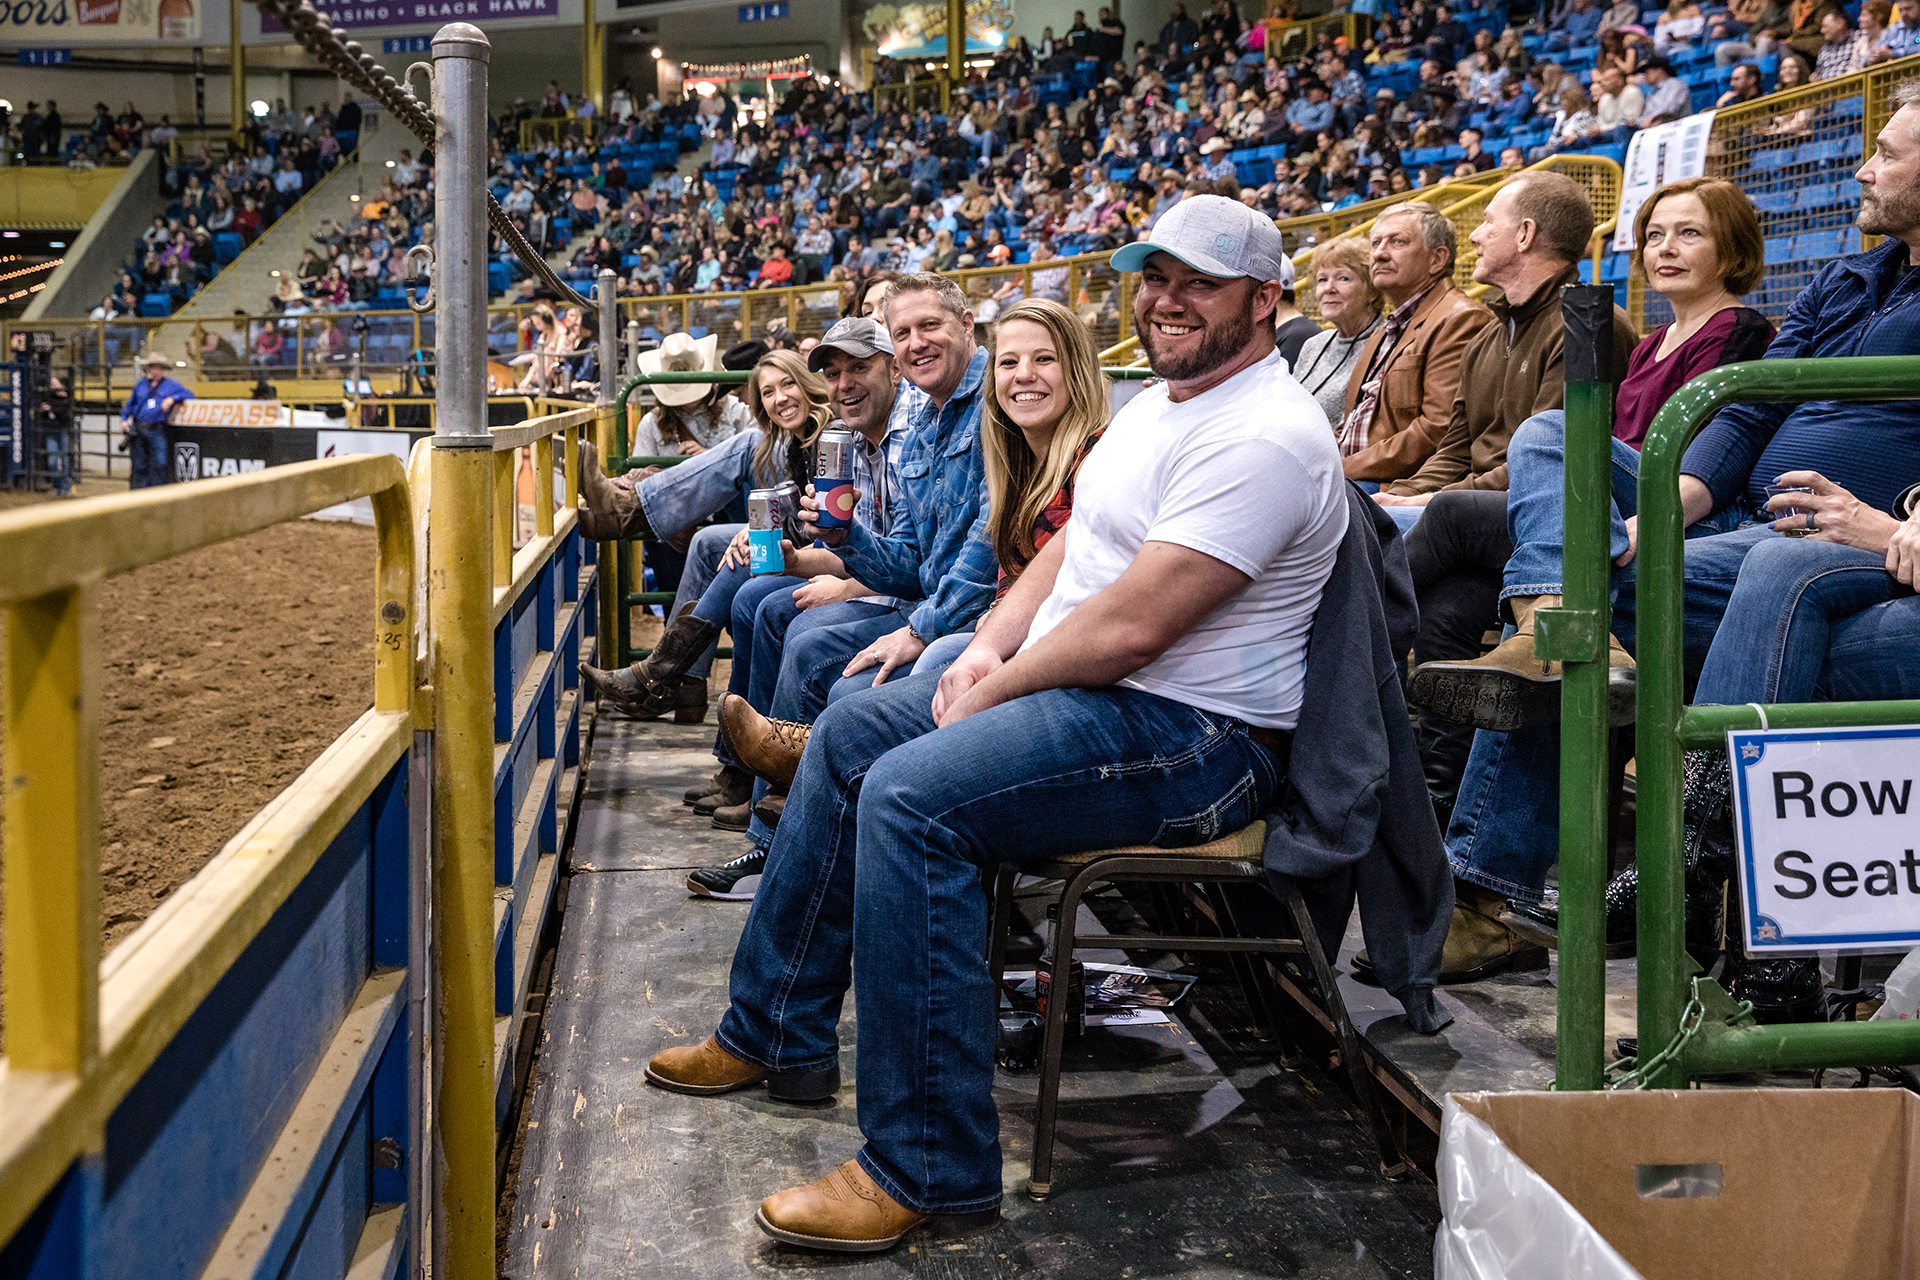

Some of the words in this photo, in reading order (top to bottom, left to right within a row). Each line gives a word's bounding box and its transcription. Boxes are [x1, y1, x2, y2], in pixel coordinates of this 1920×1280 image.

[330, 6, 389, 22] ASINO
[415, 1, 478, 17] BLACK
[489, 0, 547, 12] HAWK
[174, 404, 279, 427] RIDEPASS
[202, 457, 266, 477] RAM
[1772, 771, 1913, 819] Row
[1773, 848, 1920, 900] Seat
